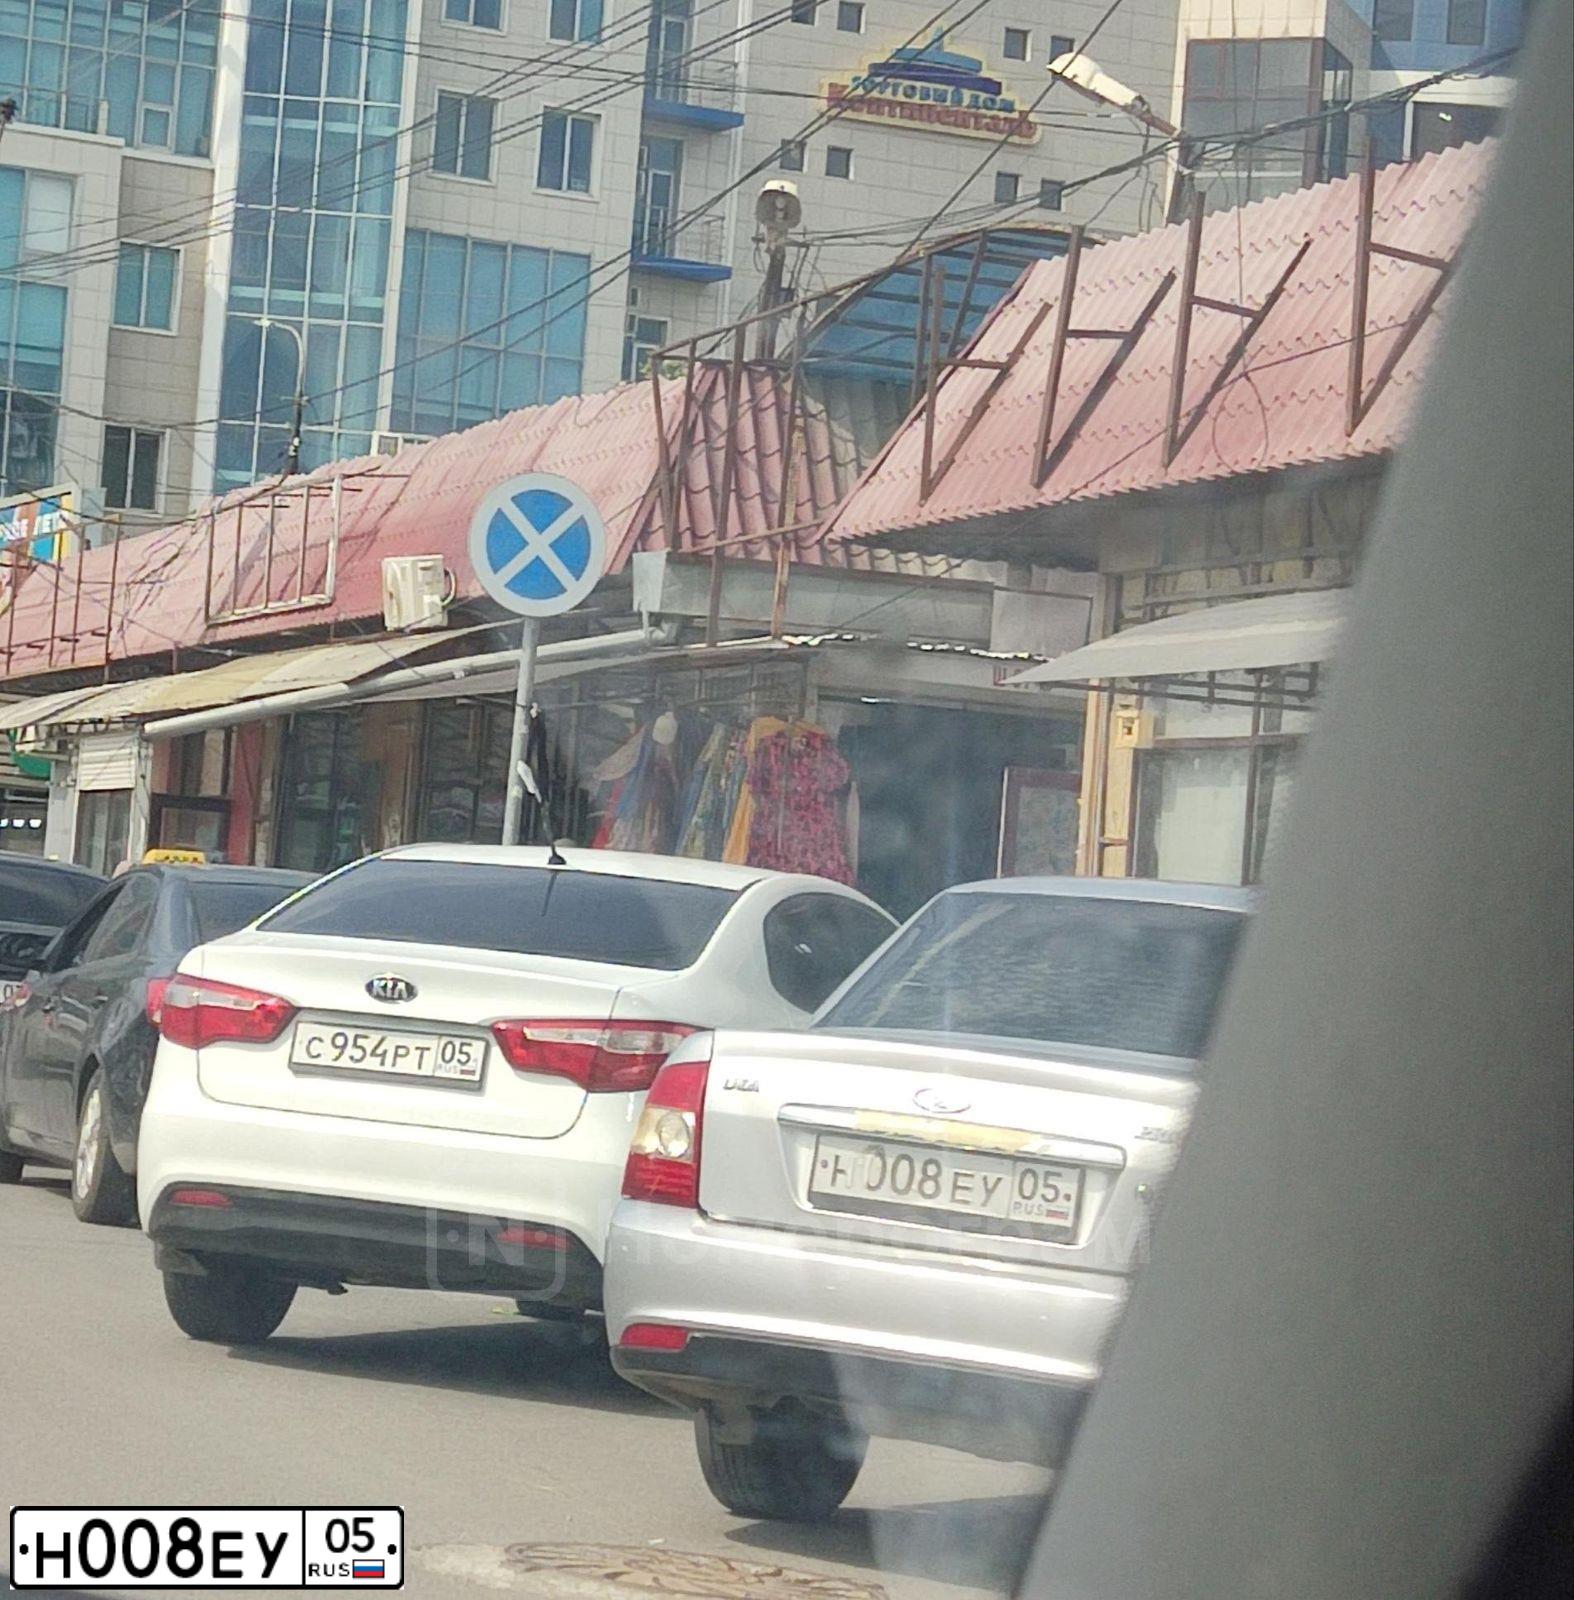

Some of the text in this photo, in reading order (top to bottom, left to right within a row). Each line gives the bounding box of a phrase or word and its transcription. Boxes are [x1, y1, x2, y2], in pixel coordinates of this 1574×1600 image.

[372, 979, 409, 999] KIA
[305, 1031, 473, 1070] С954РТ 05
[1017, 1167, 1063, 1204] 05
[1012, 1201, 1046, 1217] RUS
